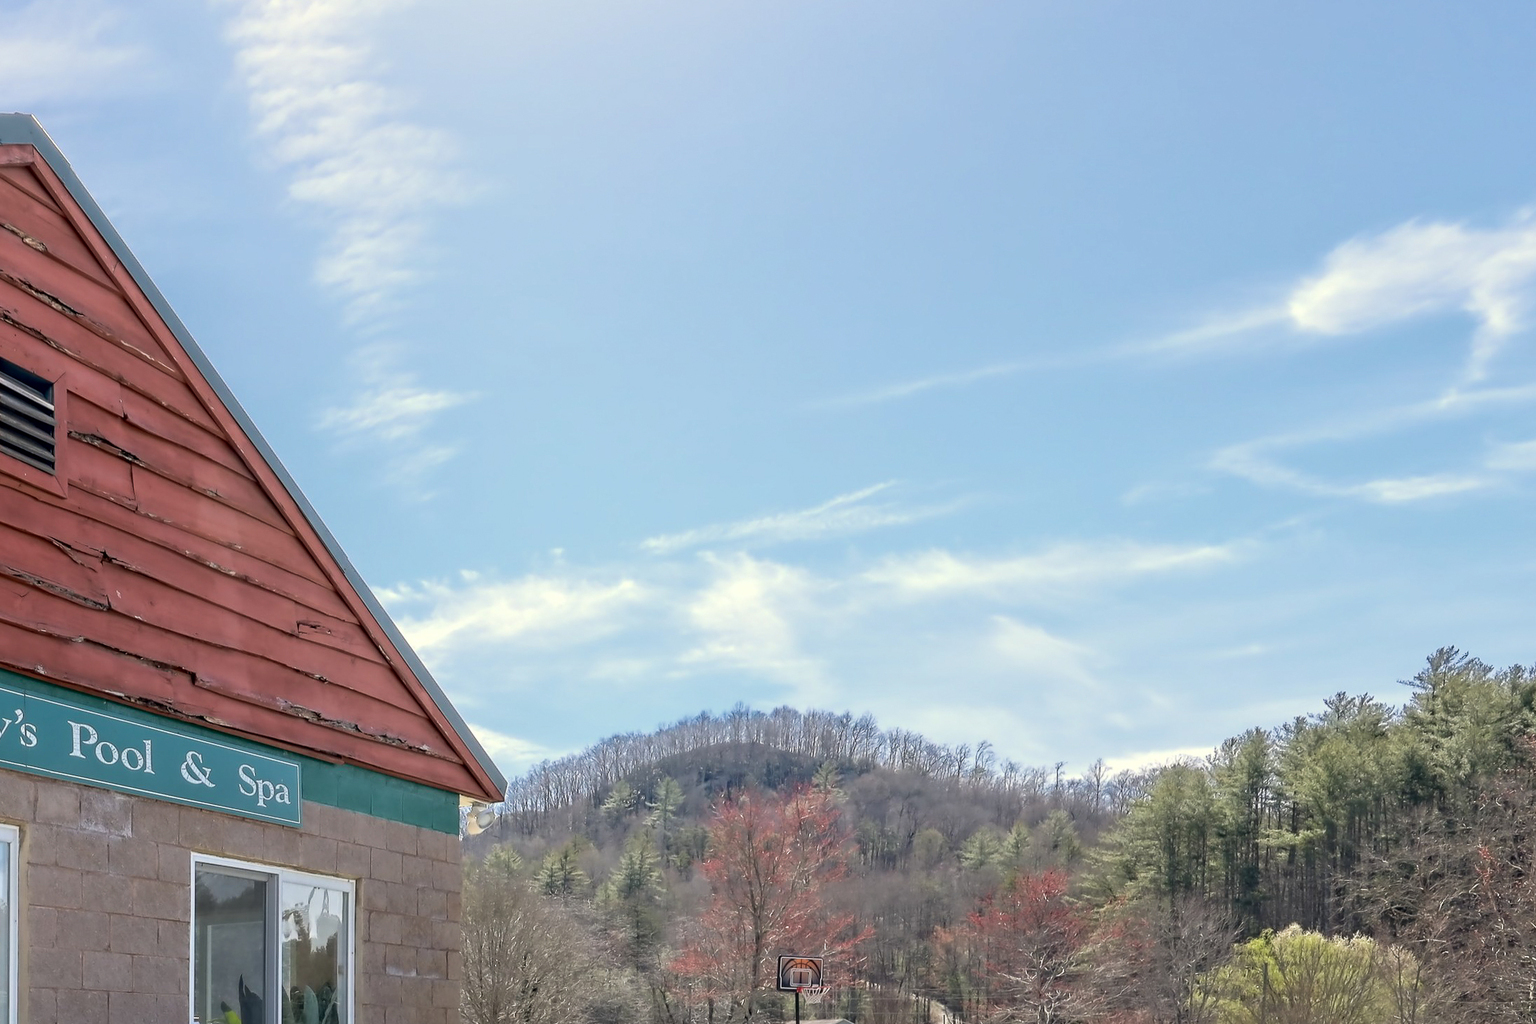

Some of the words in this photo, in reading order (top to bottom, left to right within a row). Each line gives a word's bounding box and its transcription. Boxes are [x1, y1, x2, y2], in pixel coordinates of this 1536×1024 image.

[68, 721, 155, 775] Pool
[181, 751, 216, 788] &
[238, 764, 291, 807] Spa
